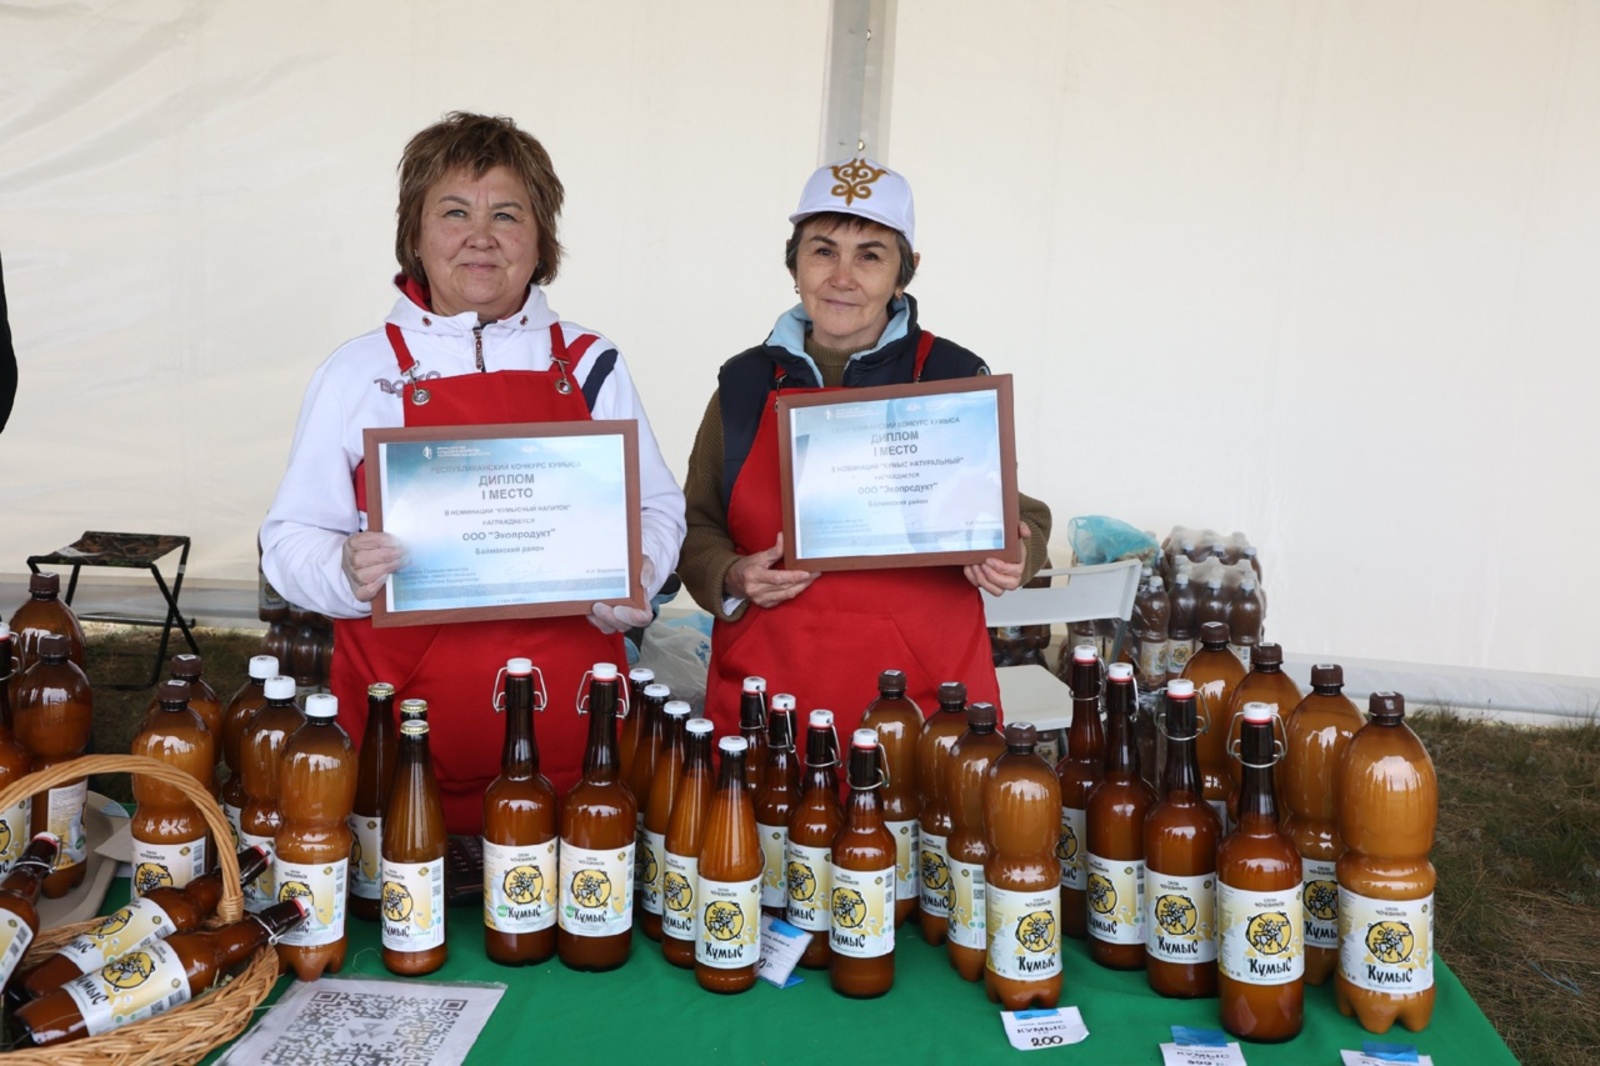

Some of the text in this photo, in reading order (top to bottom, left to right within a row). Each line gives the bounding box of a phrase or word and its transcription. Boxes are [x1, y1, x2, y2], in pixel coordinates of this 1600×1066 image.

[871, 430, 919, 445] ДИПЛОМ
[880, 444, 918, 457] МЕСТО
[430, 460, 582, 474] РЕСПУБЛИКАНСКИЙ КОНКУРС КУМЫСА
[837, 464, 879, 473] НОМИНАЦИИ
[910, 457, 964, 468] НАТУРАЛЬНЫЙ"
[478, 473, 535, 488] ДИПЛОМ
[489, 487, 534, 500] МЕСТО
[857, 482, 938, 496] ООО "Экопродукт"
[451, 508, 494, 516] НОМИНАЦИИ
[482, 518, 535, 526] НАГРАЖДАЕТСЯ
[462, 528, 556, 543] ООО "Экопродукт"
[475, 545, 545, 556] Баймакский район
[1031, 1035, 1063, 1047] 200
